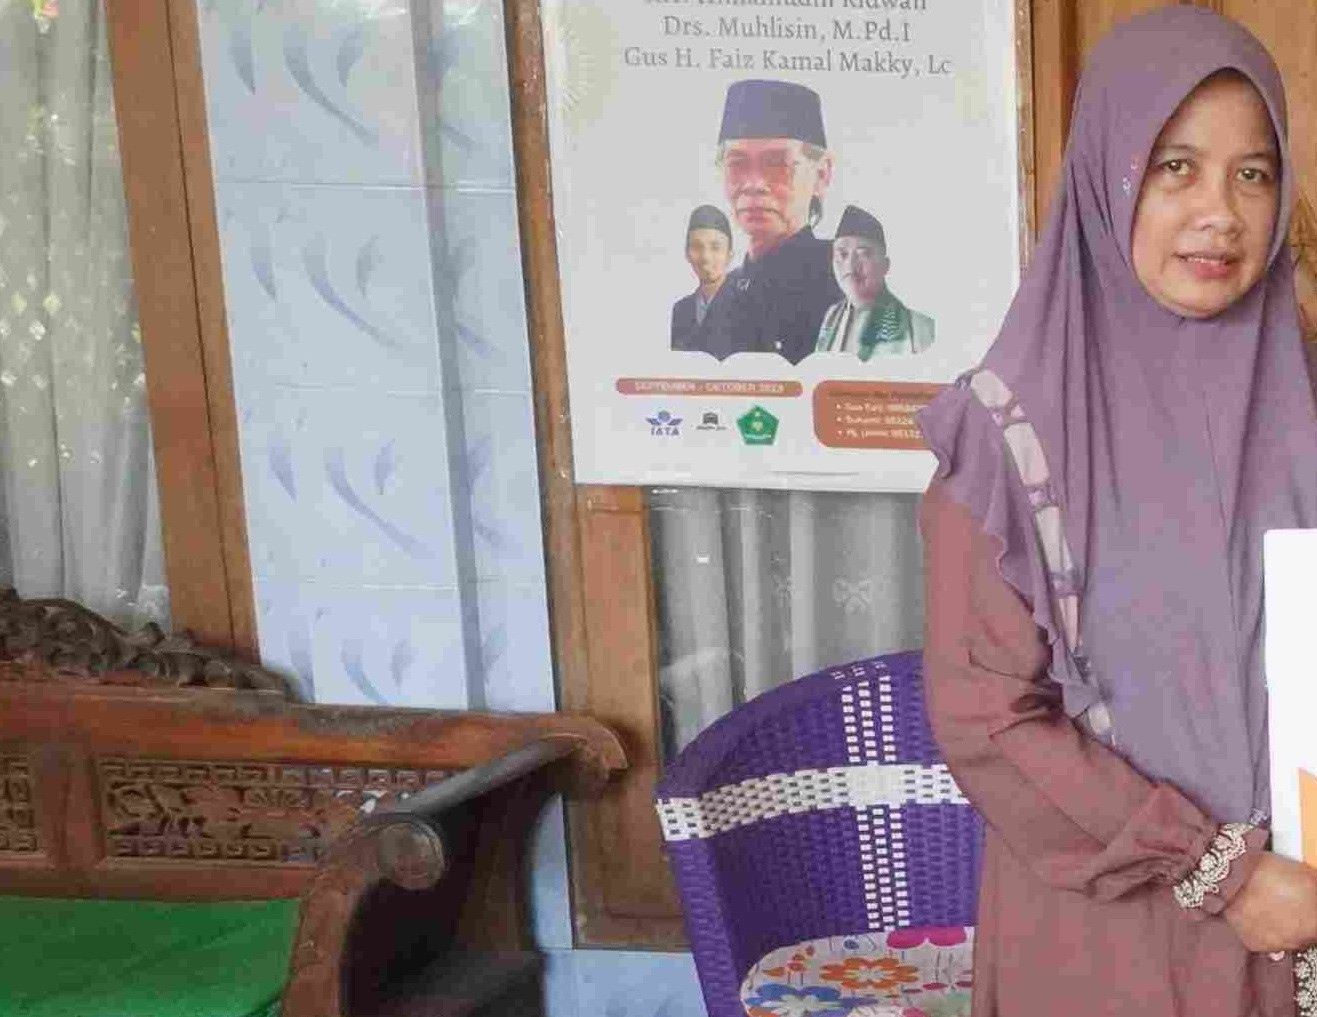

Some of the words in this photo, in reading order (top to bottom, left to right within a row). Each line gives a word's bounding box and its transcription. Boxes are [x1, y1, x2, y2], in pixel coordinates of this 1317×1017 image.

[663, 15, 709, 37] Drs.
[718, 15, 826, 44] Muhlisin,
[833, 20, 912, 42] M.Pd.I
[623, 47, 669, 67] Gus
[675, 48, 700, 69] H.
[708, 48, 755, 69] Faiz
[763, 49, 832, 72] Kamal
[840, 52, 921, 79] Makky,
[929, 54, 954, 75] Lc
